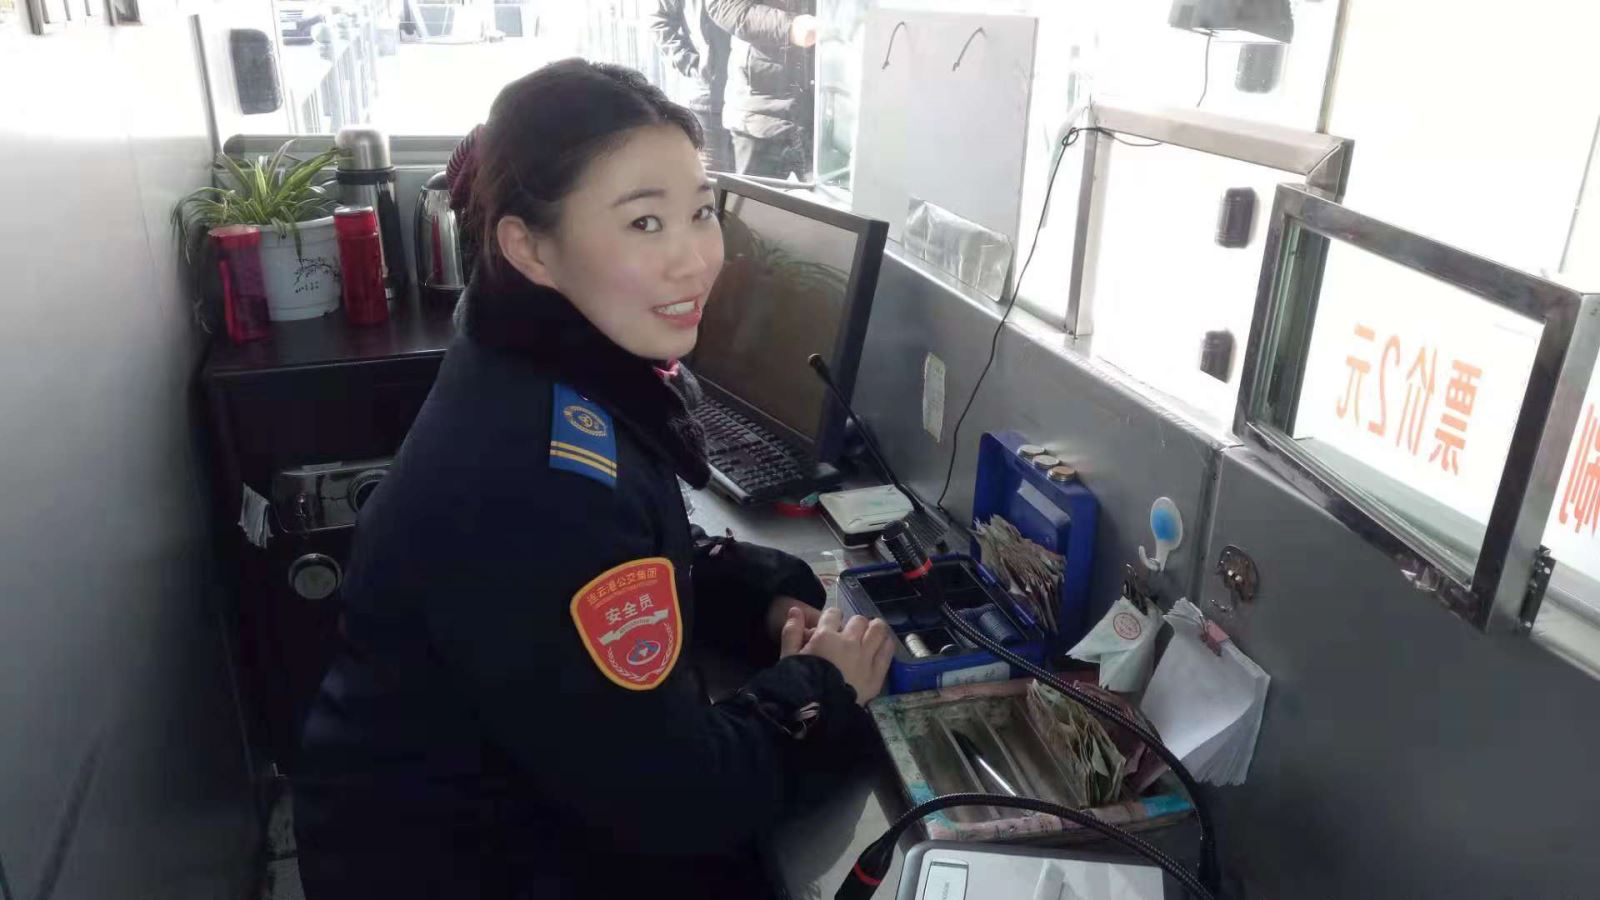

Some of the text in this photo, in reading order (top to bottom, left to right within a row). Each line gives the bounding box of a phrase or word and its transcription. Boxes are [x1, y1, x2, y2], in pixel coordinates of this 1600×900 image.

[586, 567, 658, 606] 连云港公交集团
[605, 593, 655, 625] 安全员
